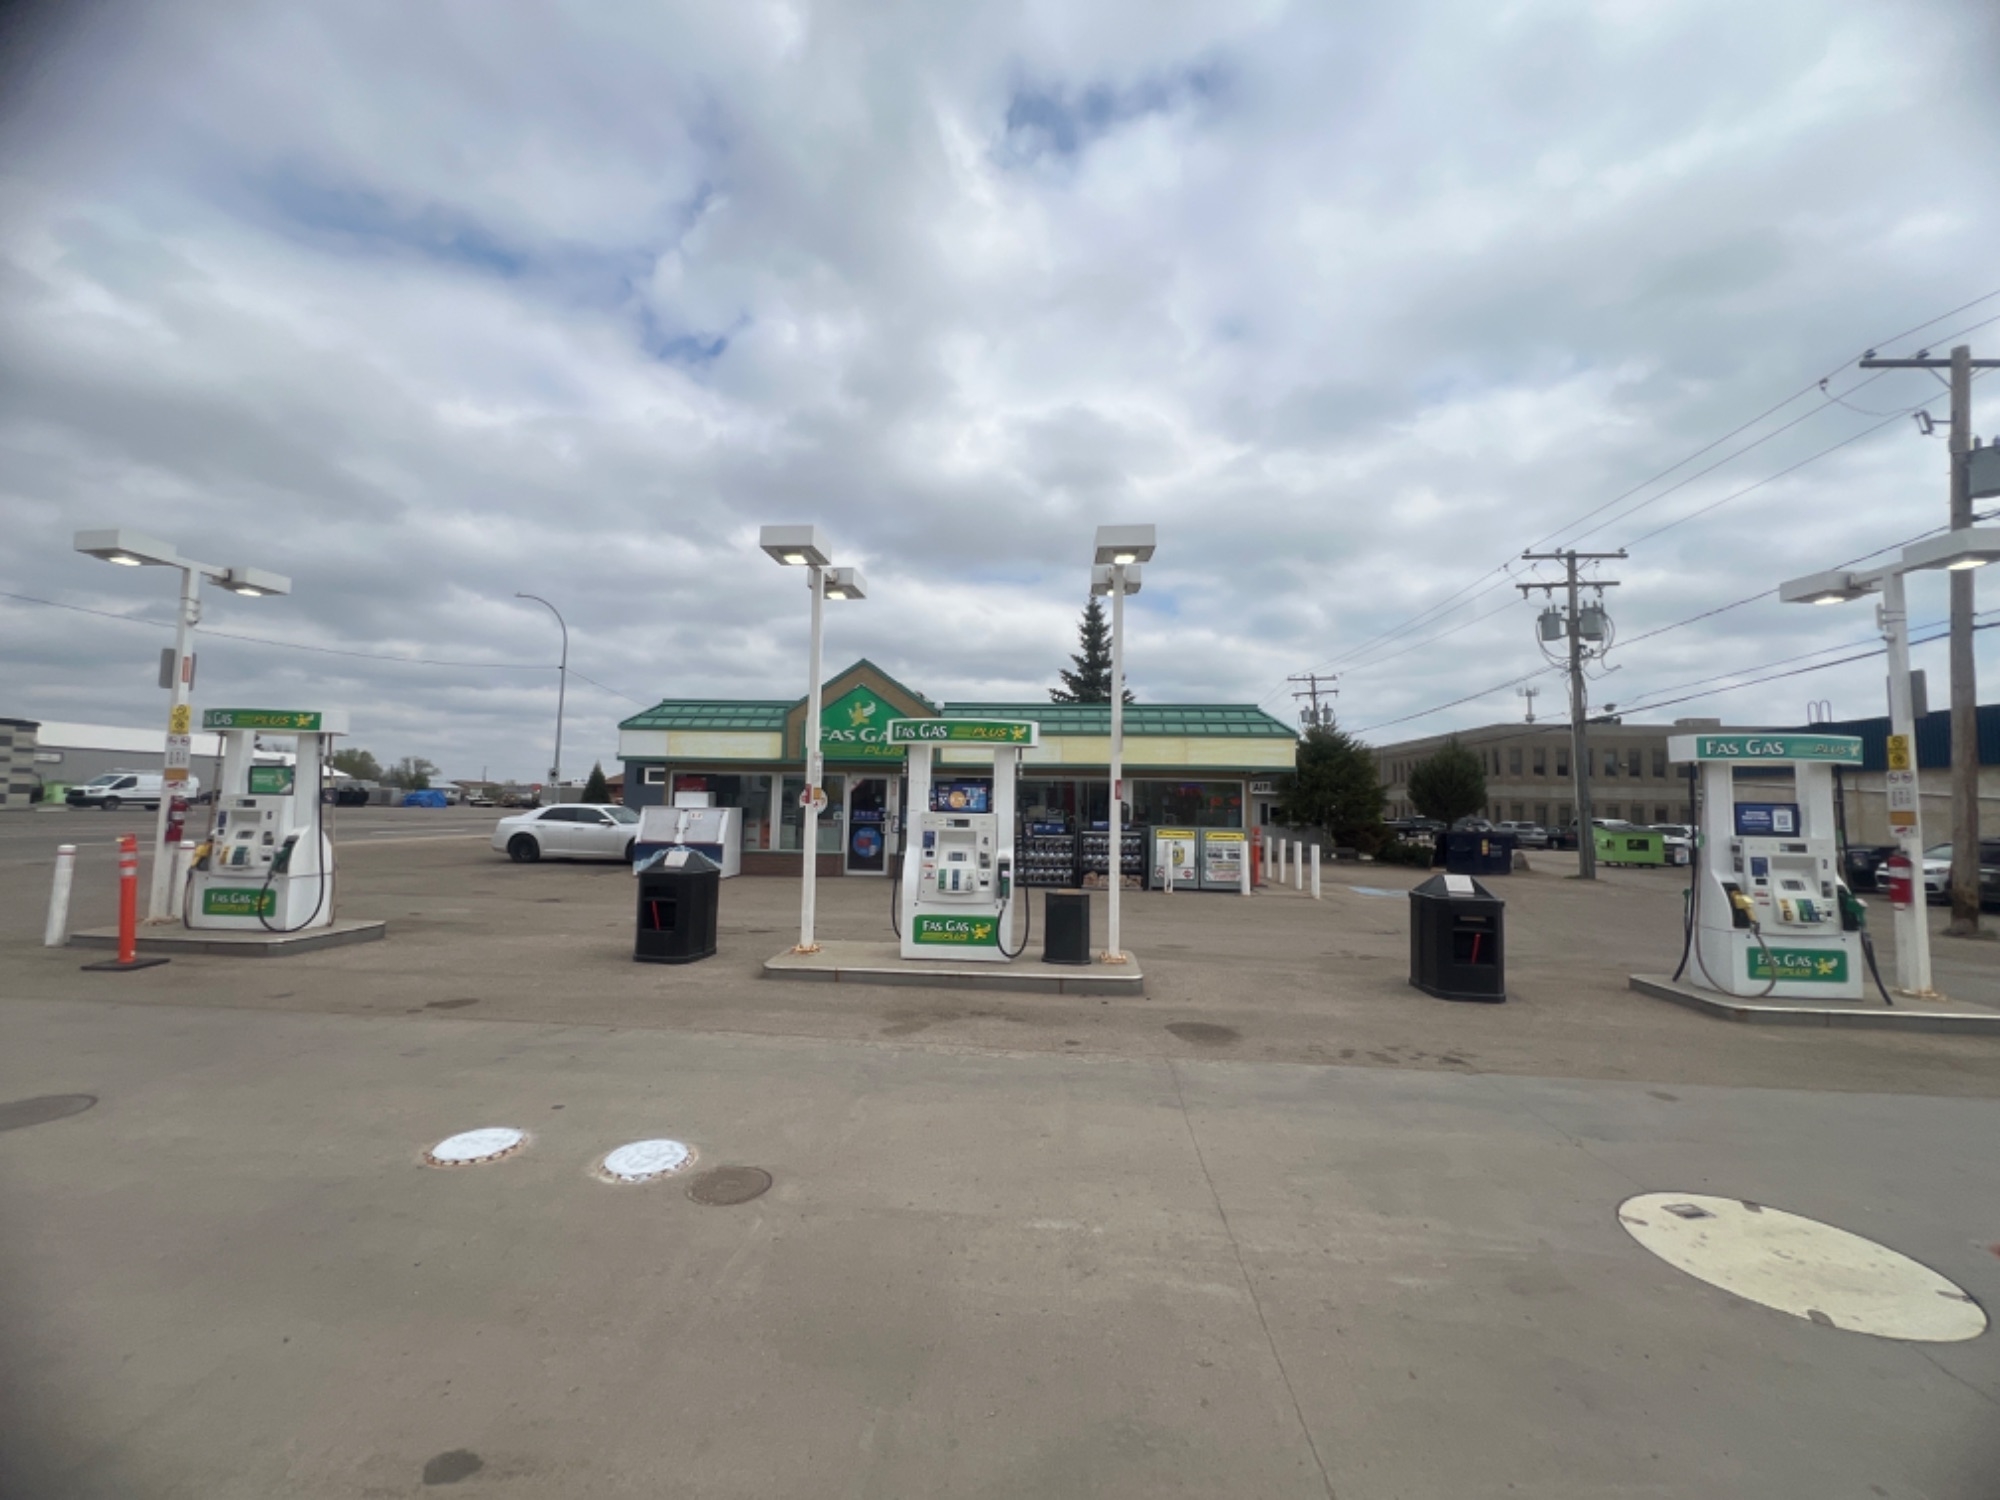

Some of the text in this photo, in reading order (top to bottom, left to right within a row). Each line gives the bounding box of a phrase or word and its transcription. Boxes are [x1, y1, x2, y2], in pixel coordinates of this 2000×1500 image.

[214, 712, 233, 725] GAS
[254, 715, 291, 726] PLUS
[895, 723, 1007, 739] FAS GAS PLUS
[1705, 739, 1847, 755] FAS GAS PLUS
[211, 892, 252, 904] FAS GAS
[922, 920, 970, 932] FAS GAS
[1783, 953, 1813, 968] GAS
